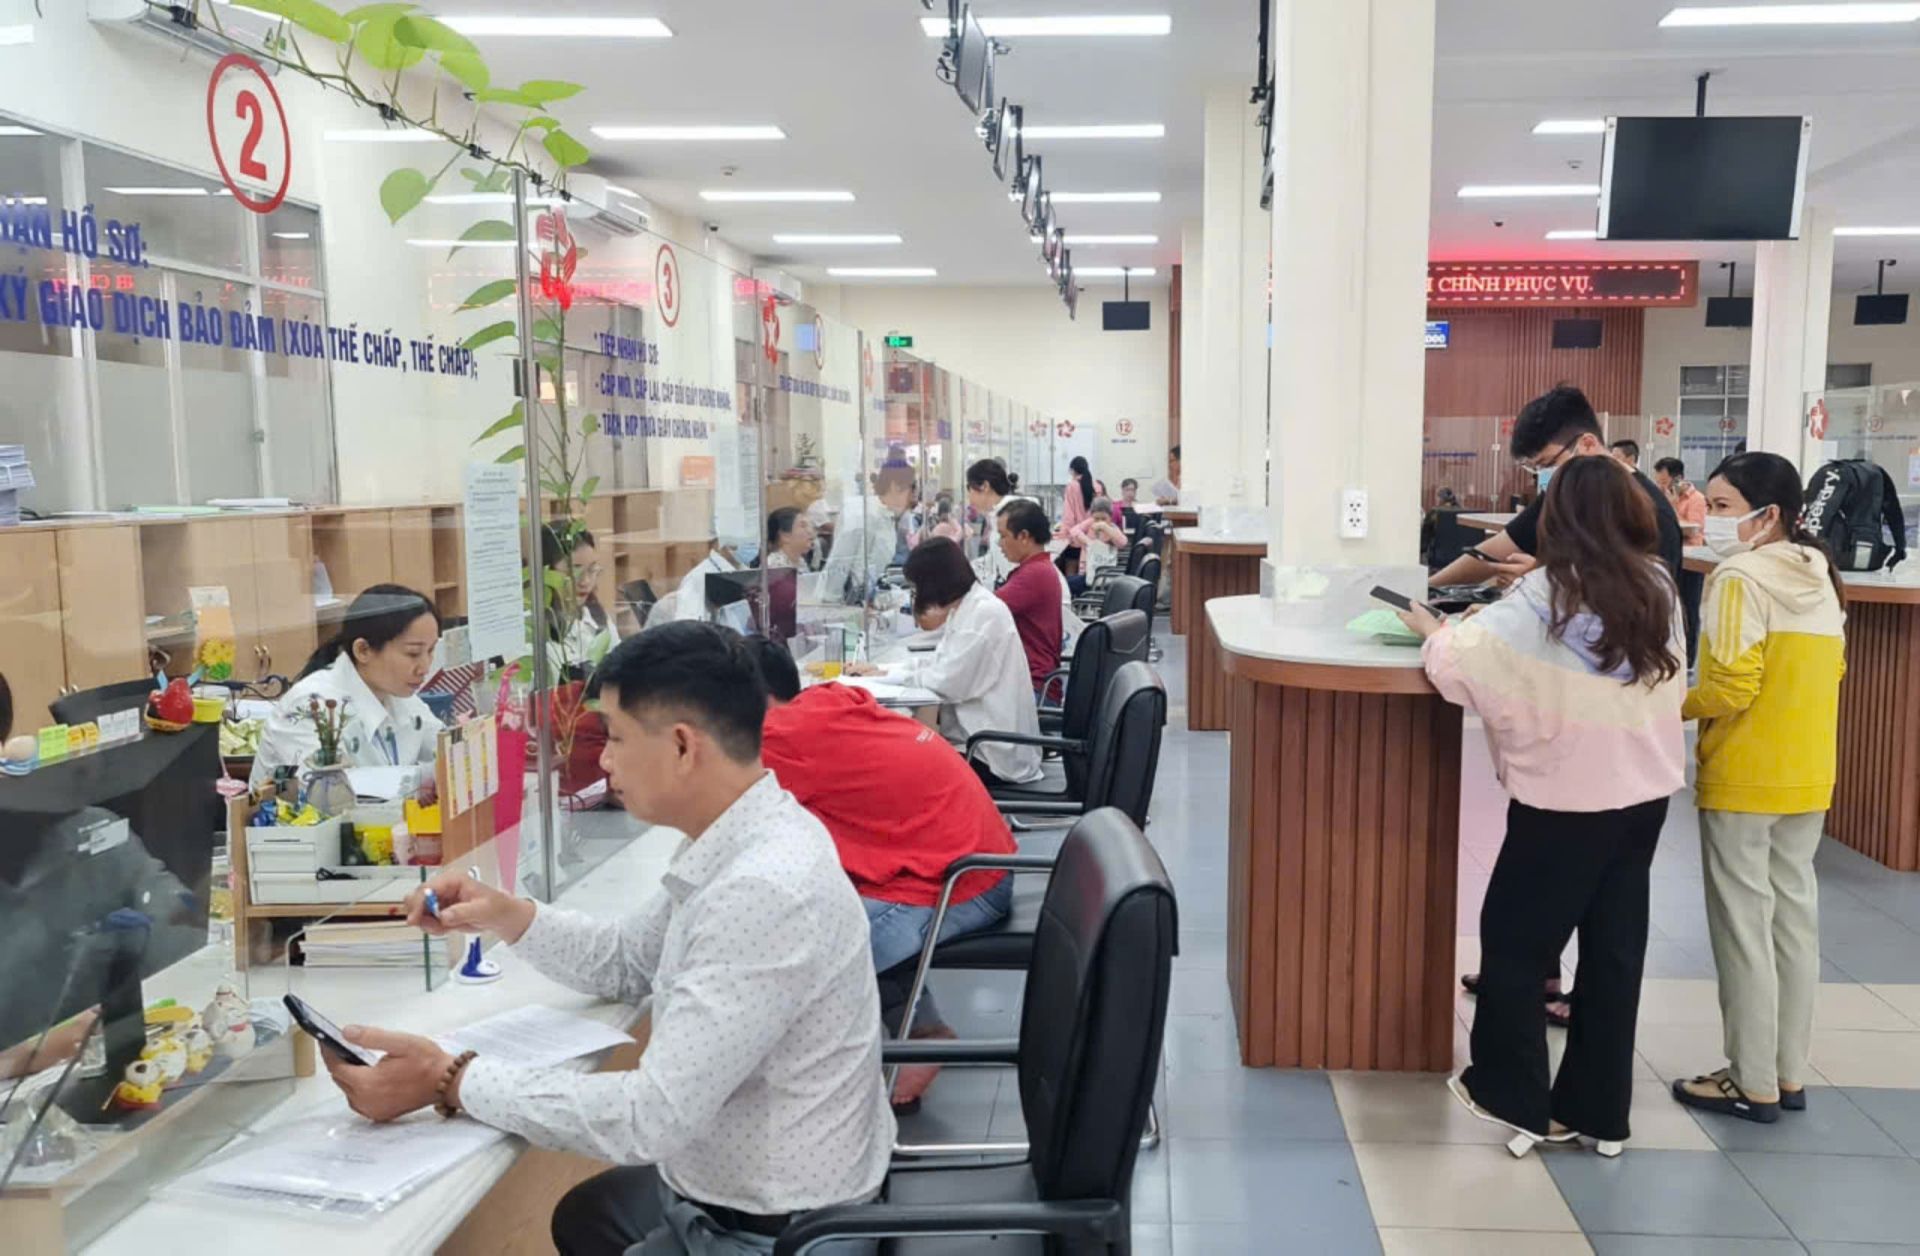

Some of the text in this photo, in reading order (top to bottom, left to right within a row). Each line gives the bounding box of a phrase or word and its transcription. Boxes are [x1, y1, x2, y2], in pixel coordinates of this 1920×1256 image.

[236, 89, 267, 181] 2
[61, 204, 97, 258] HỒ
[663, 262, 672, 309] 3
[1438, 273, 1500, 293] CHÍNH
[1503, 276, 1557, 294] PHỤC
[1560, 275, 1594, 294] VỤ.
[39, 280, 104, 331] GIAO
[113, 291, 171, 345] DỊCH
[178, 291, 223, 346] BẢO
[229, 301, 276, 353] ĐẢM
[282, 314, 324, 358] (XÓA
[328, 322, 359, 363] THẾ
[363, 328, 407, 372] CHẤP,
[410, 334, 434, 372] THẾ
[438, 337, 478, 380] CHẤP);
